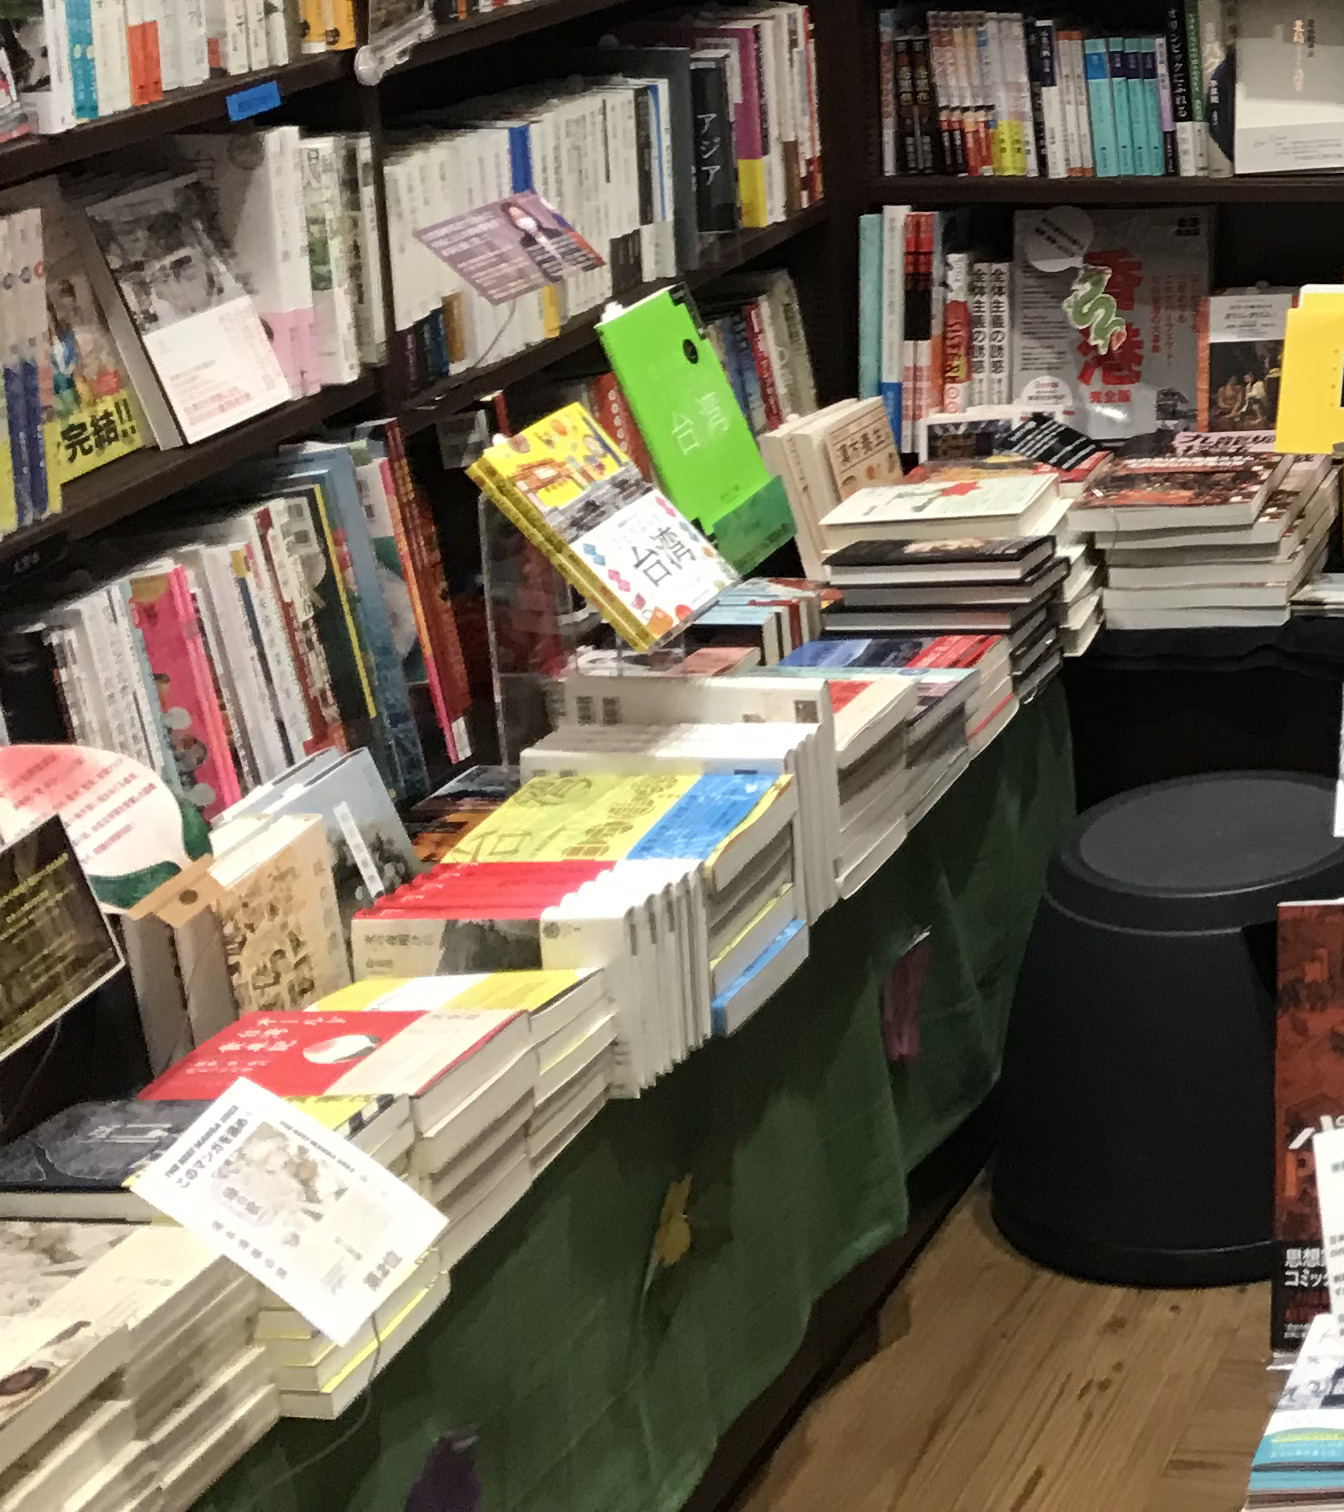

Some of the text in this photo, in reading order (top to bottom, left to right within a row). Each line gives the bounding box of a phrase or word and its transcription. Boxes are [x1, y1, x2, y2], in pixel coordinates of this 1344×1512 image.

[972, 266, 987, 373] 全体主義の誘惑
[990, 266, 1006, 373] 全体主義の誘惑
[631, 525, 698, 587] 台湾
